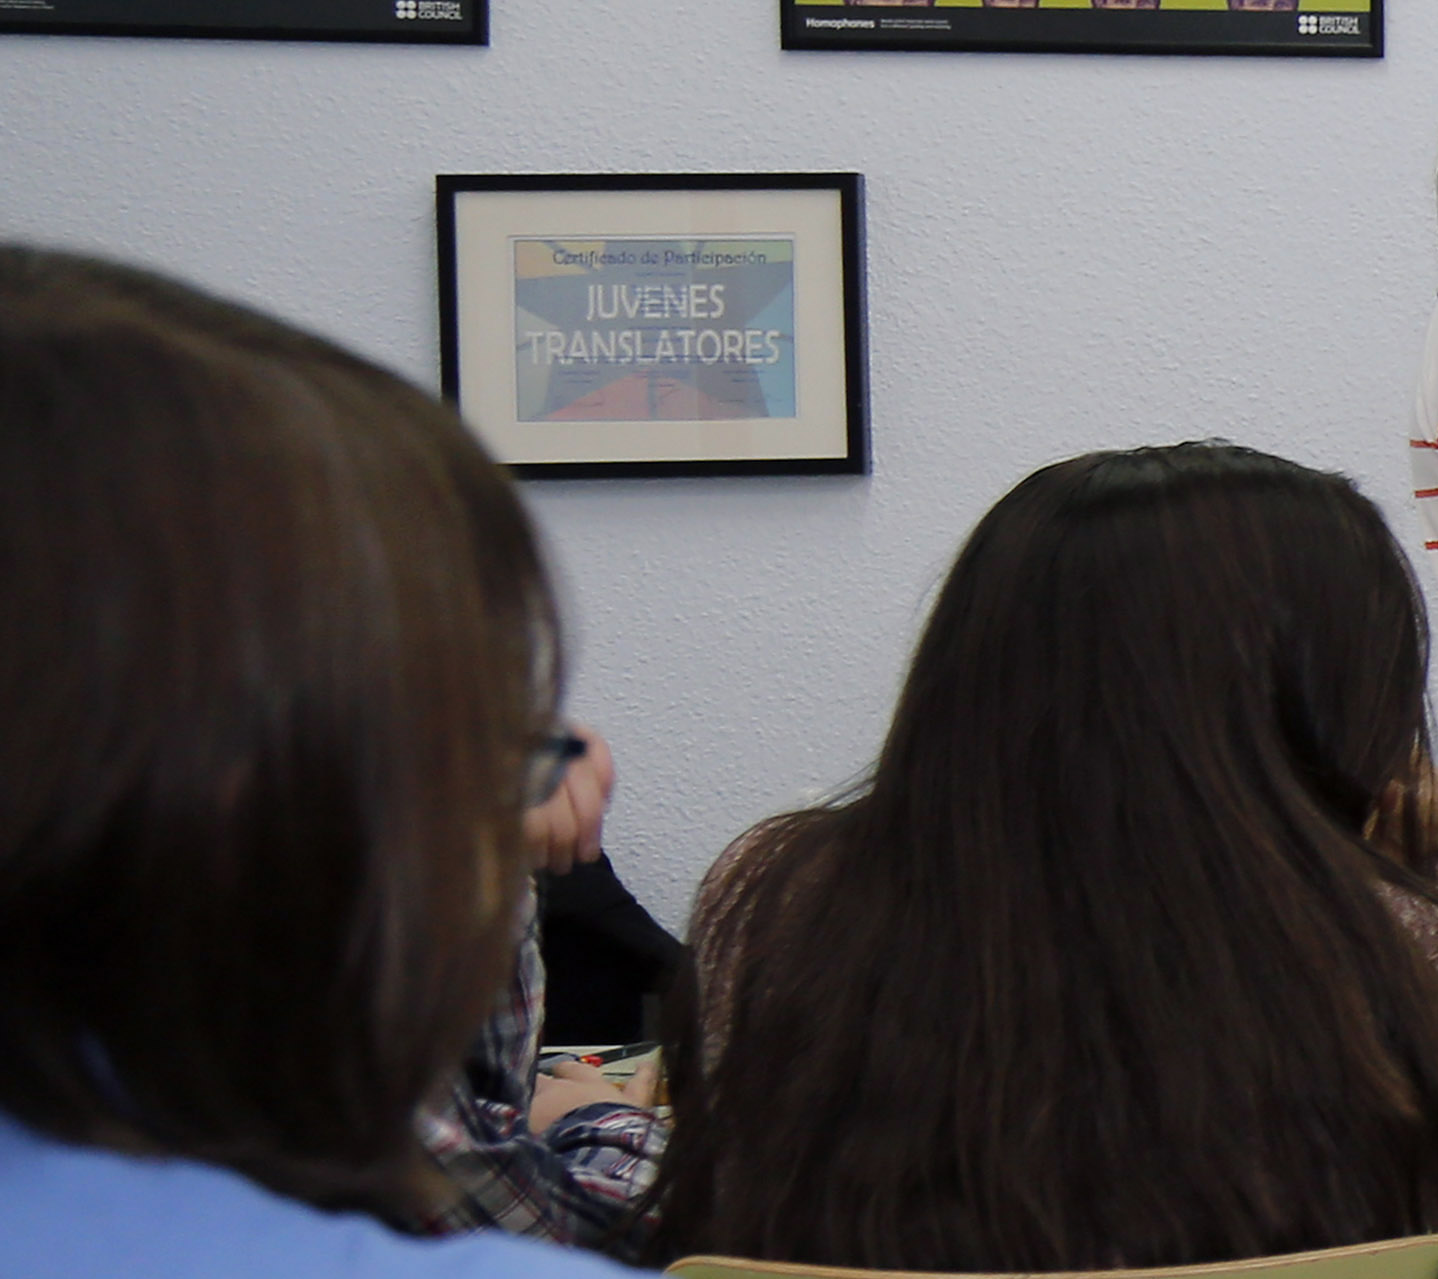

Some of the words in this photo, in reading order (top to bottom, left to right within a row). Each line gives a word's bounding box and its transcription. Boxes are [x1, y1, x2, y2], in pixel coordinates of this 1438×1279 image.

[418, 1, 460, 11] BRITISH
[418, 11, 463, 20] COUNCIL
[1319, 16, 1358, 26] BRITISH
[806, 18, 875, 30] Homophones
[1319, 25, 1360, 35] COUNCIL
[553, 251, 635, 268] Certificado
[640, 252, 660, 265] de
[664, 251, 767, 267] Participación
[586, 285, 726, 320] JUVENES
[526, 331, 781, 365] TRANSLATORES
